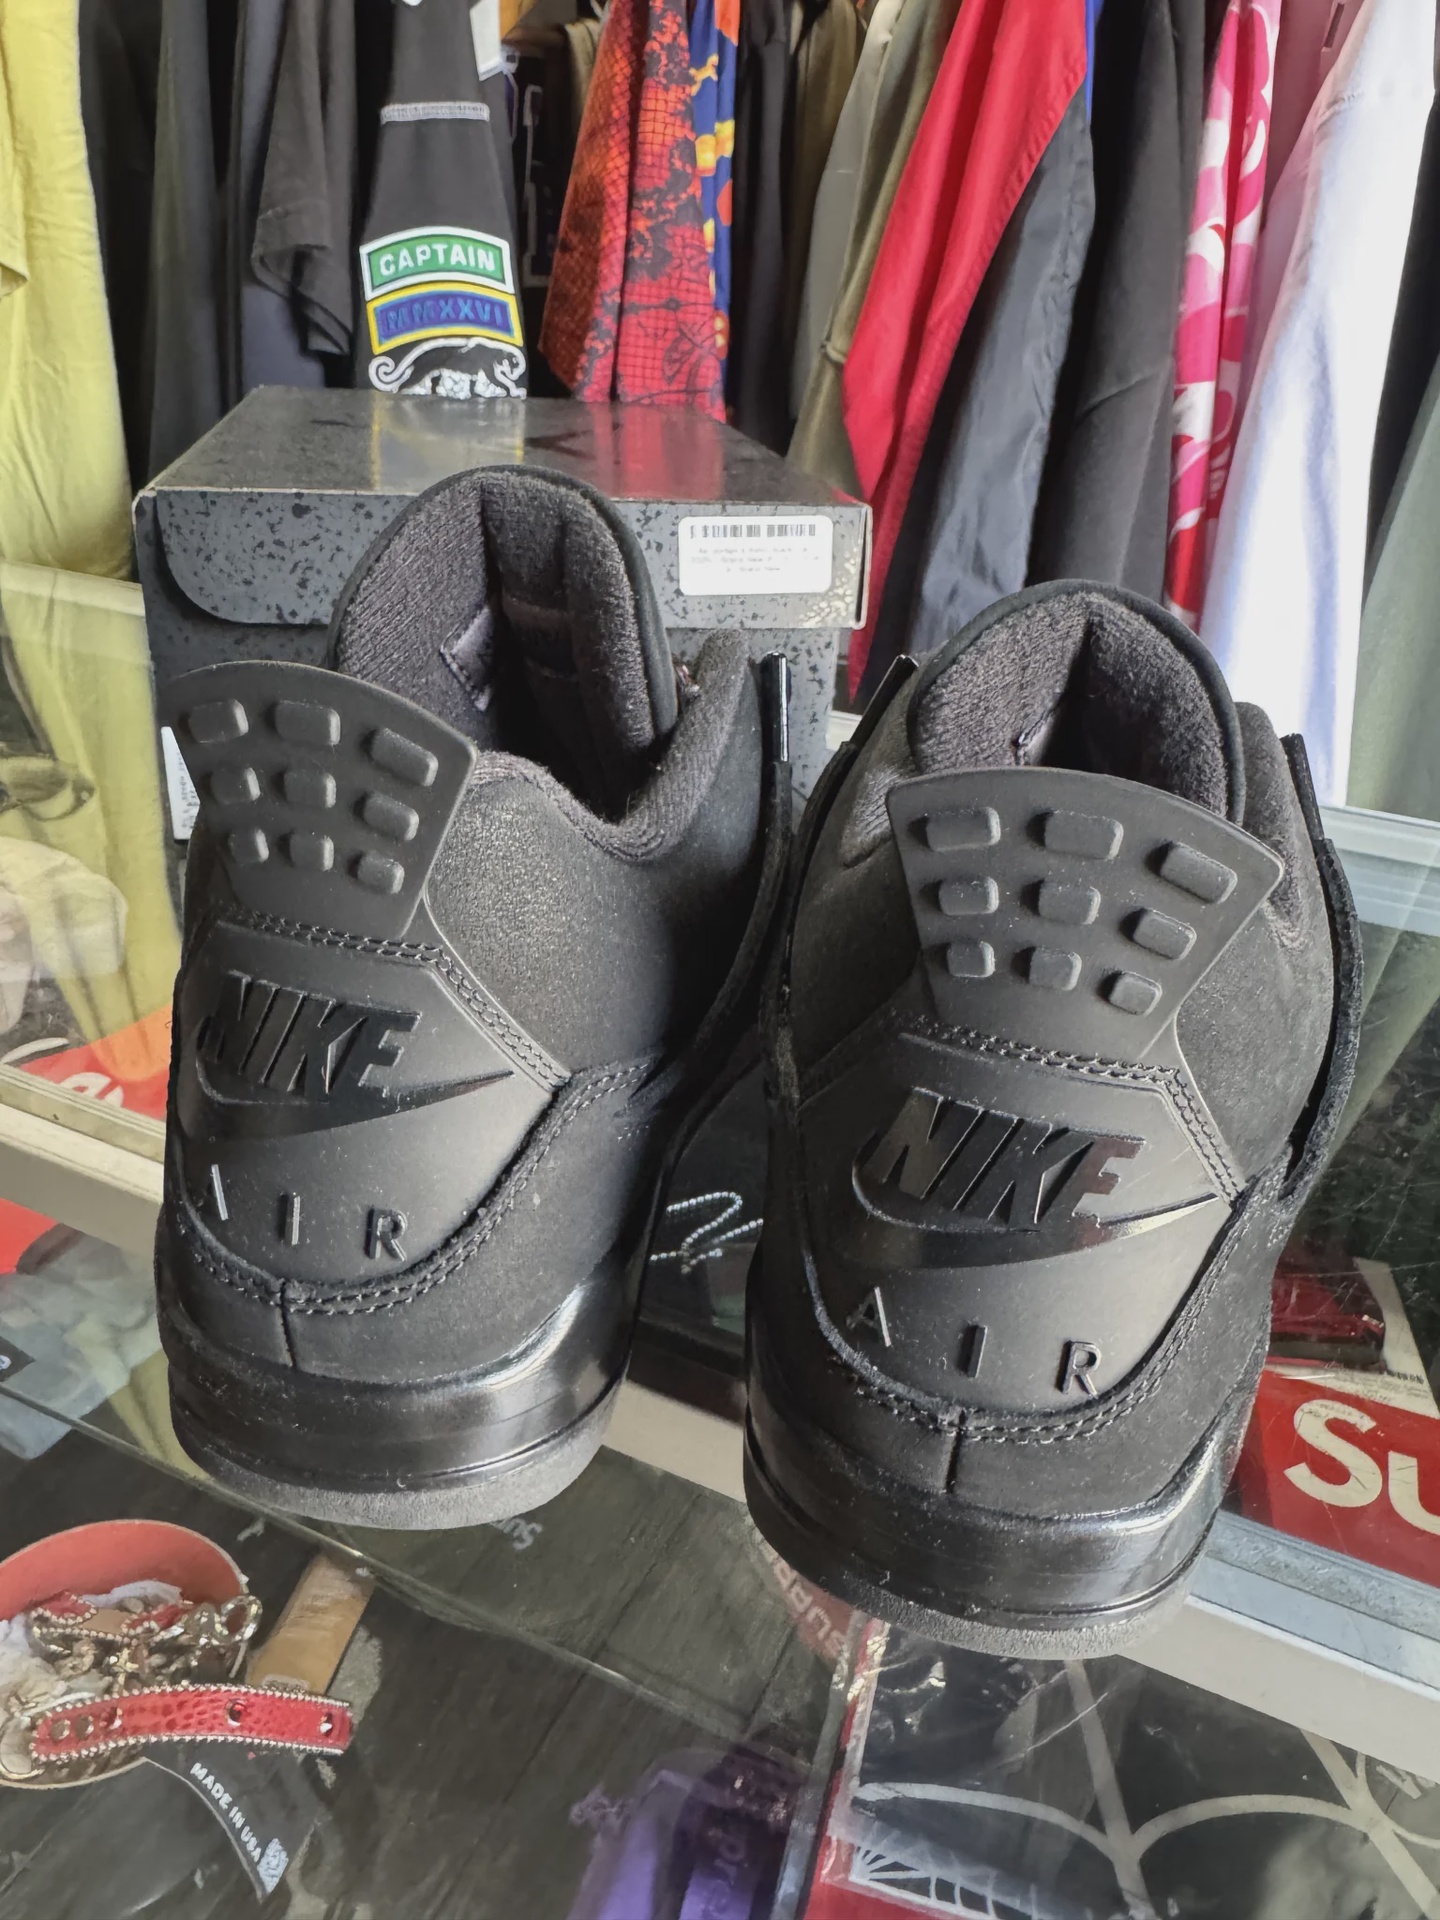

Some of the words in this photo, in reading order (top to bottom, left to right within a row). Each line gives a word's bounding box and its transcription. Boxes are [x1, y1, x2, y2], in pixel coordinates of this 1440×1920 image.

[379, 243, 495, 276] CAPTAIN
[387, 298, 503, 332] MMXXVI
[203, 968, 422, 1099] NIKE
[865, 1086, 1147, 1227] NIKE
[846, 1286, 1102, 1399] AIR
[190, 1762, 233, 1810] MADE
[229, 1806, 246, 1829] IN
[240, 1826, 262, 1862] USA
